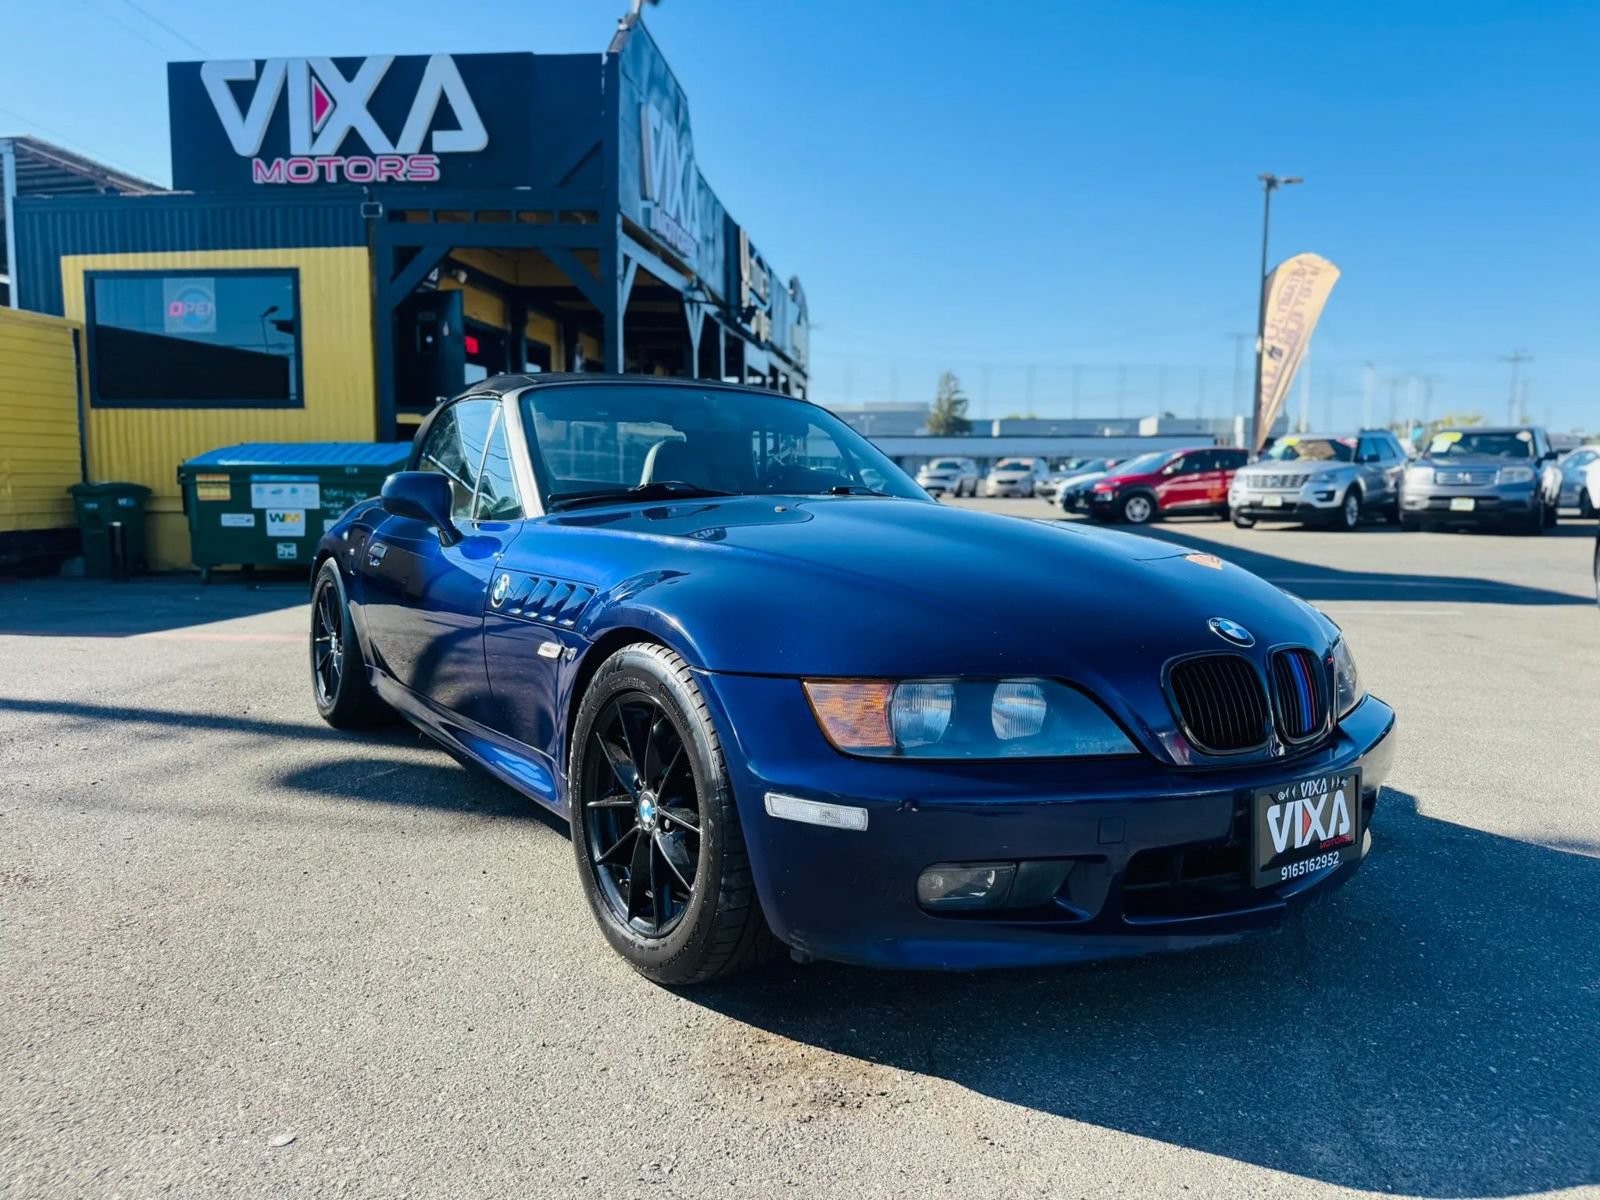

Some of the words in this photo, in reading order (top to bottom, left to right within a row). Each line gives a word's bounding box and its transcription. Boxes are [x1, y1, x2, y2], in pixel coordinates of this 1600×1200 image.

[200, 53, 489, 158] VIXA
[252, 154, 441, 185] MOTORS
[1300, 777, 1328, 798] VIXA
[1266, 789, 1351, 854] VIXA
[1281, 851, 1340, 880] 9165162952
